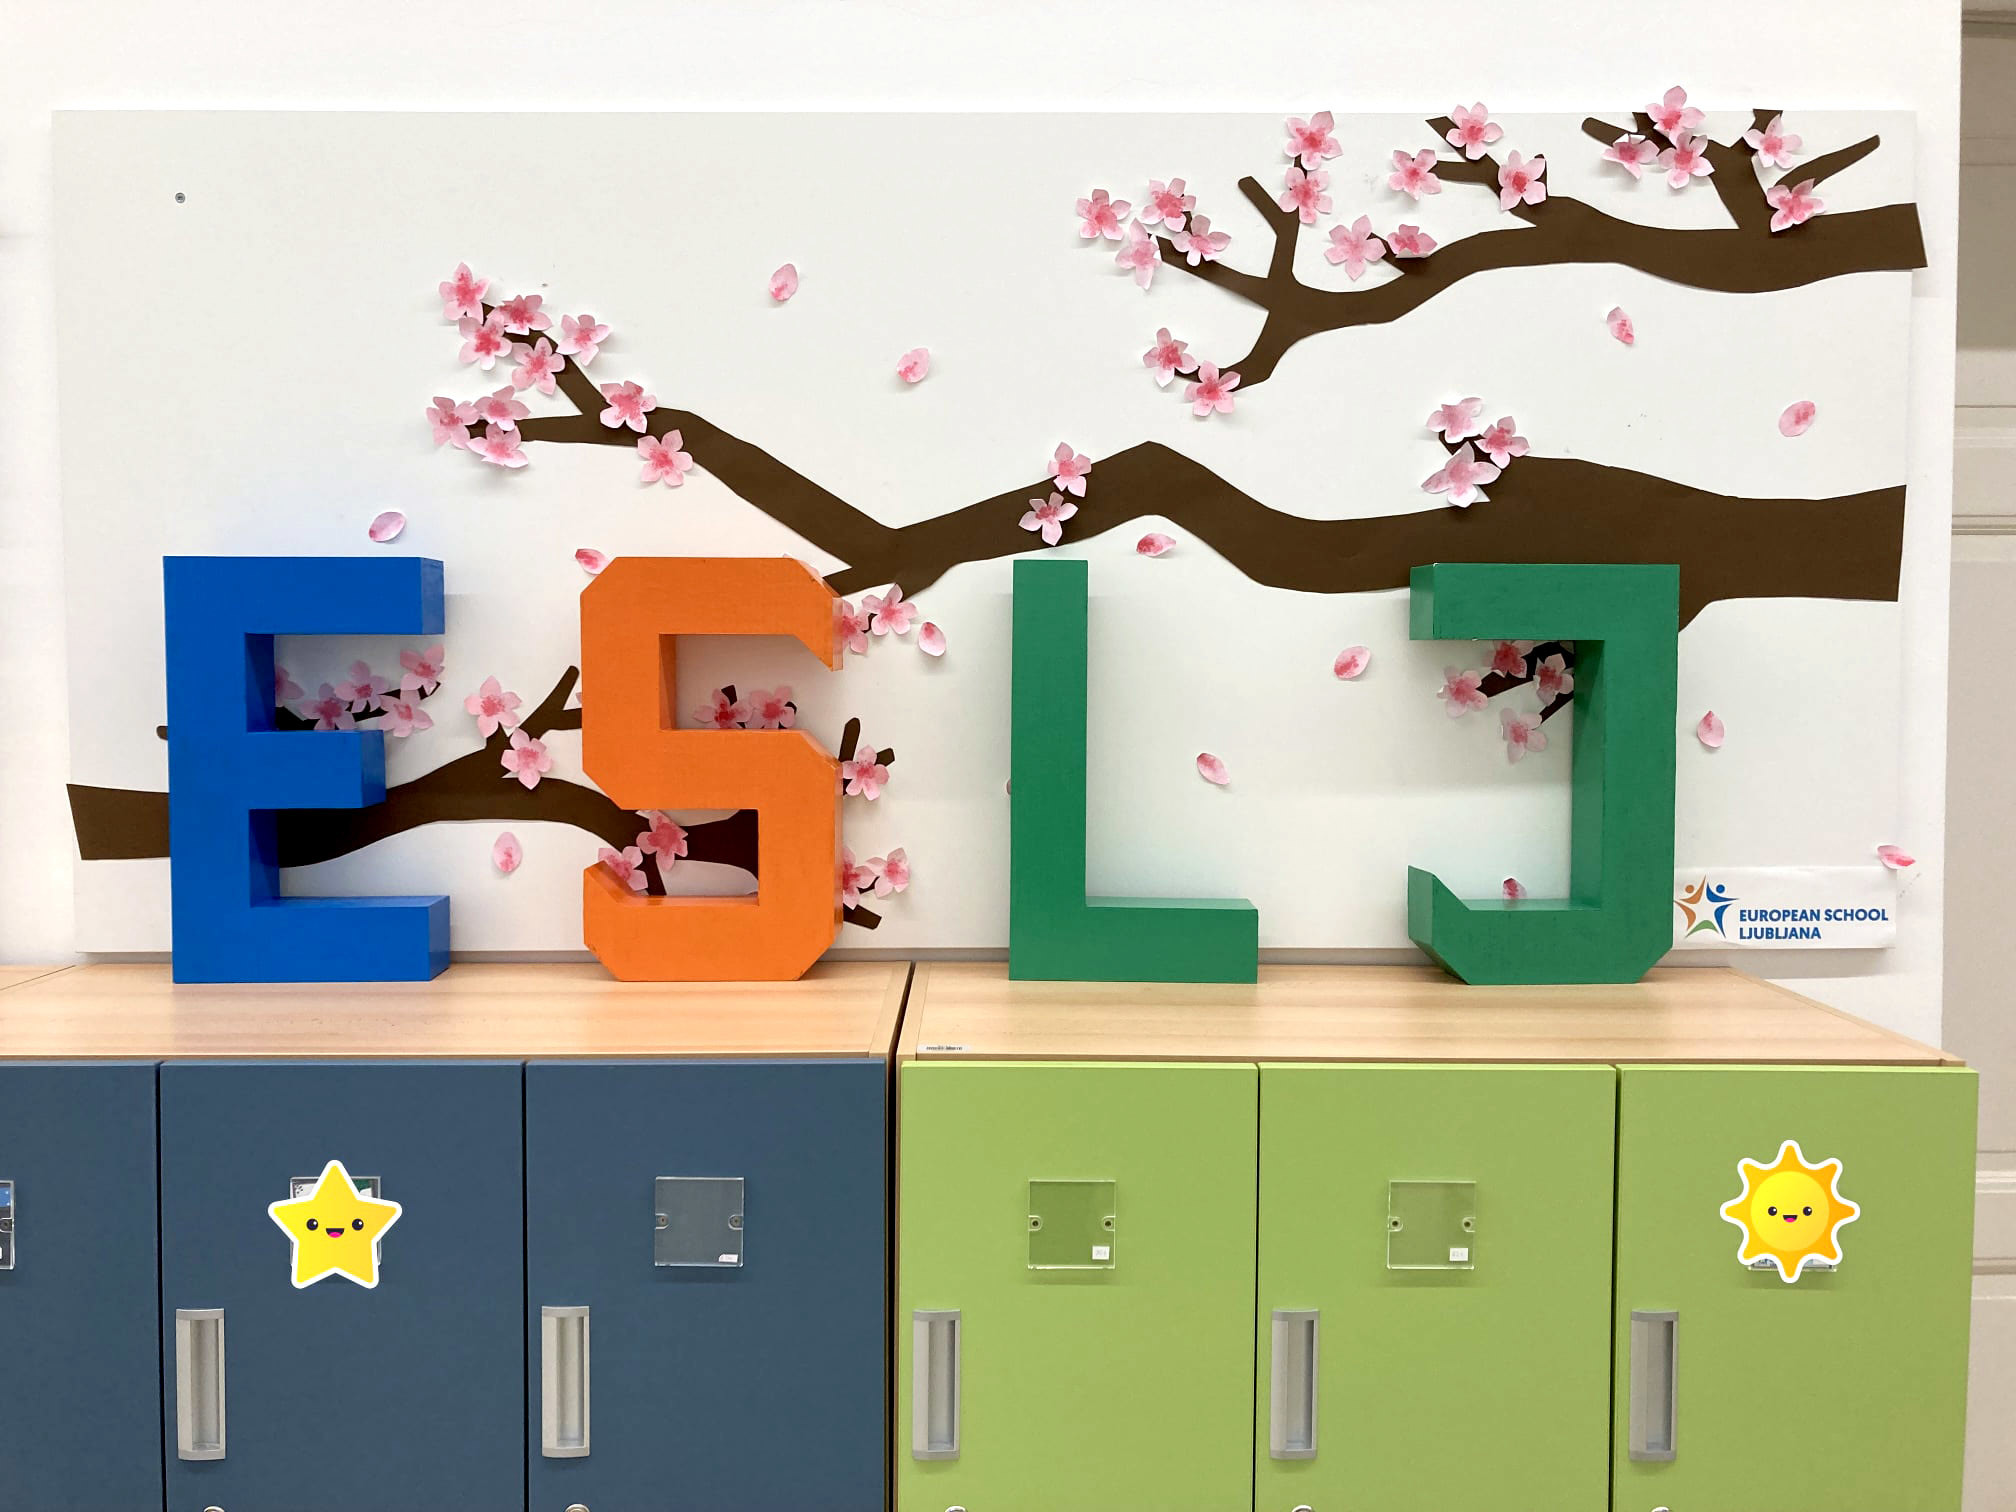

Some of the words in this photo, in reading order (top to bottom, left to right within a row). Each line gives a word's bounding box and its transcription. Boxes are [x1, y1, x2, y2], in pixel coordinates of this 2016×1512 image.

[1739, 909, 1821, 922] EUROPEAN
[1824, 908, 1889, 922] SCHOOL
[1739, 927, 1822, 940] LJUBLJANA
